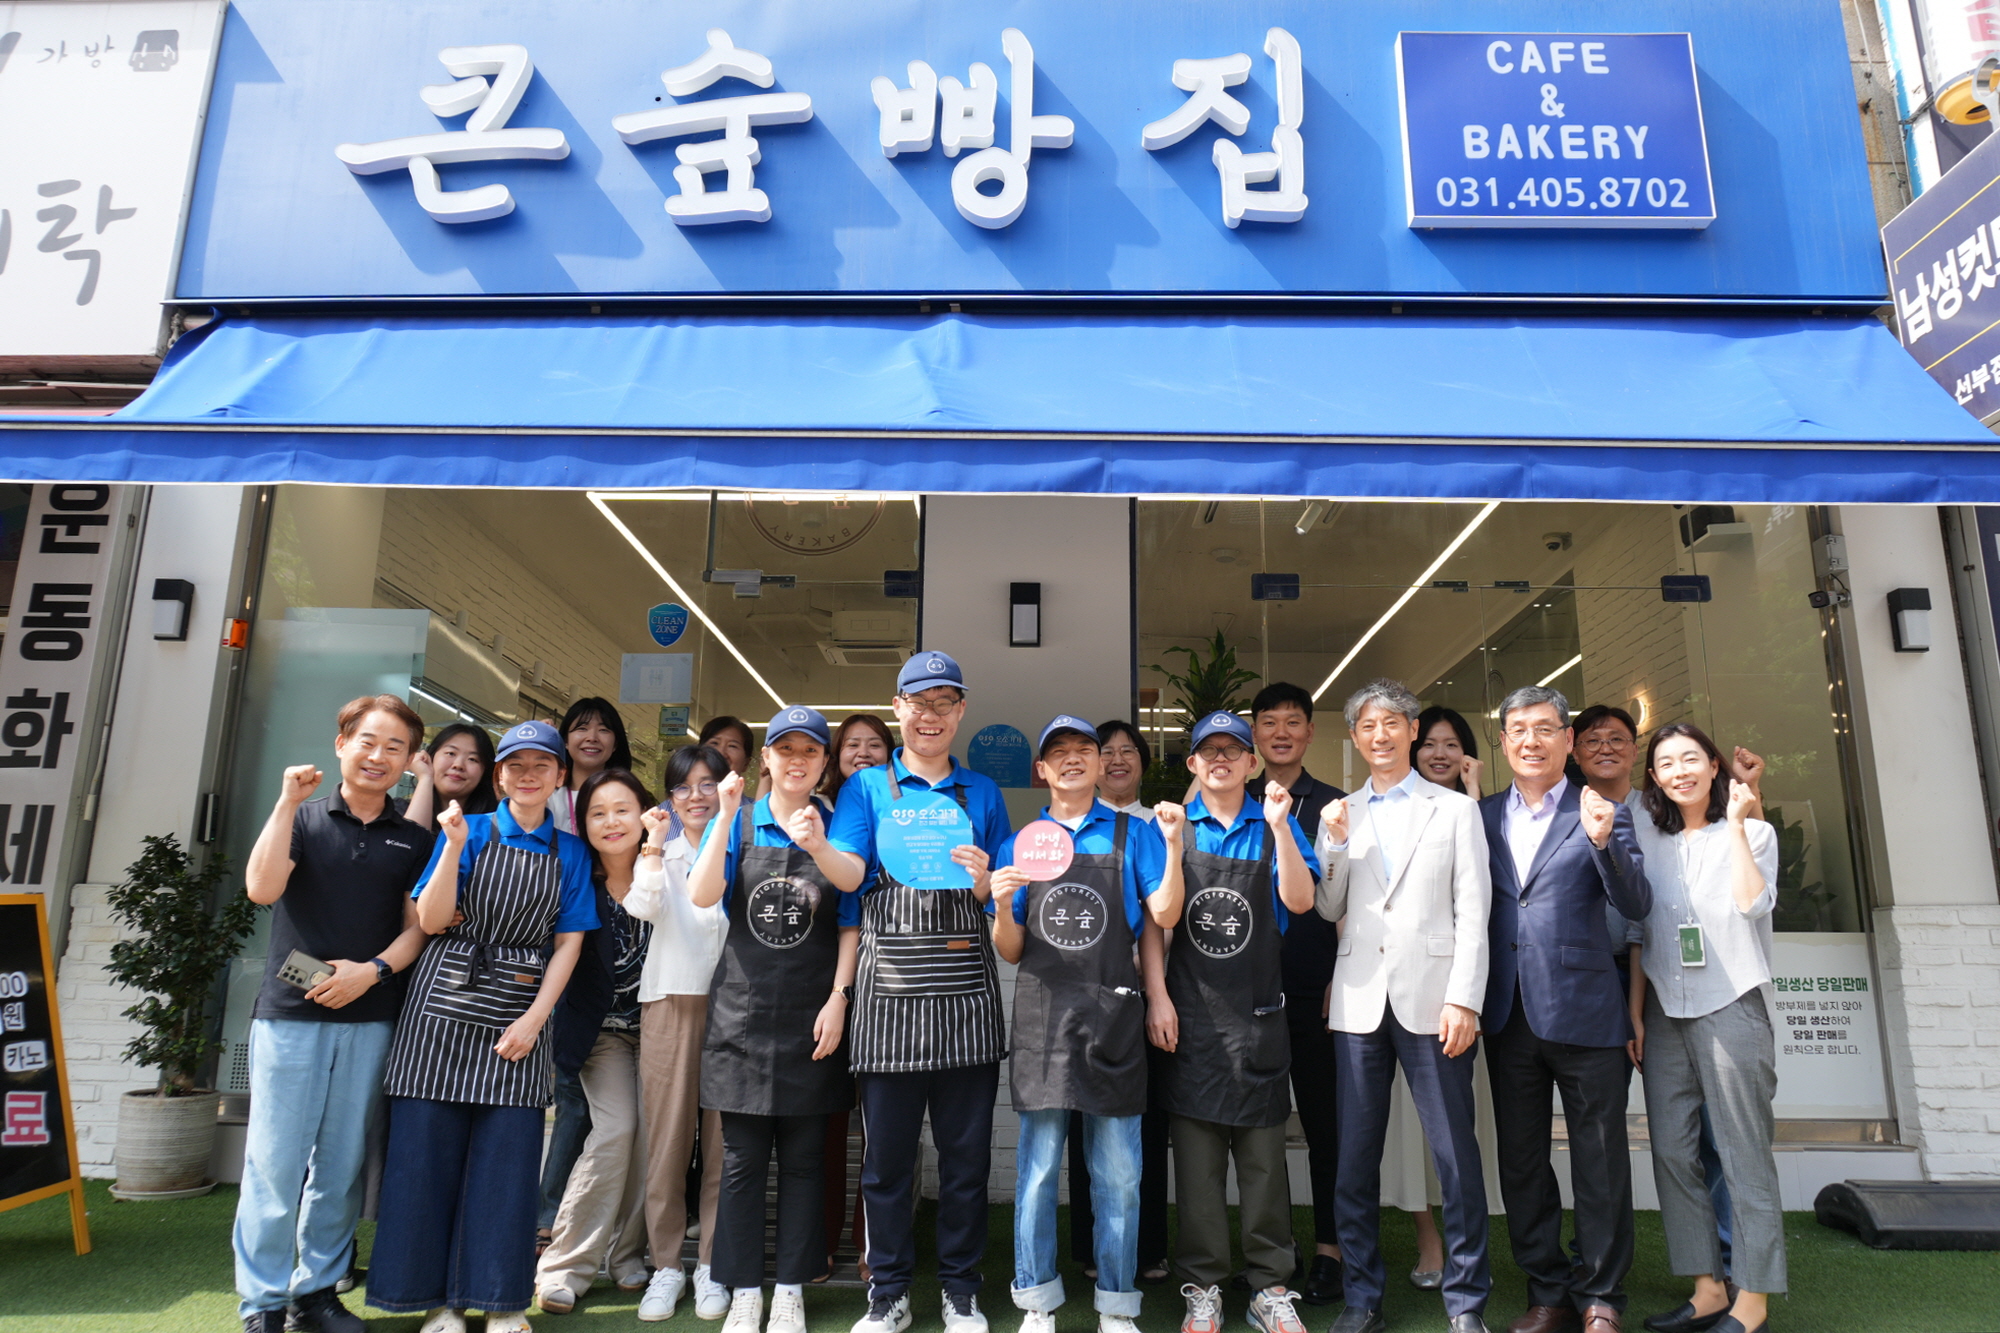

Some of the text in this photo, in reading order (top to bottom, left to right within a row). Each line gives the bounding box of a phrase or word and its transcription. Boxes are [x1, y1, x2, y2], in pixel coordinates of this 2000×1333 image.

[36, 34, 116, 69] 가방
[1486, 40, 1610, 75] CAFE
[1540, 82, 1566, 119] &
[1462, 123, 1649, 160] BAKERY
[1436, 176, 1690, 210] 031.405.8702
[1899, 214, 2000, 345] 남성컷
[651, 616, 685, 625] CLEAN
[655, 625, 679, 635] ZONE
[1047, 887, 1100, 905] BIGFOREST
[1194, 891, 1247, 912] BIGFOREST
[1816, 977, 1869, 992] 당일판매
[1775, 1000, 1816, 1011] 방부제를
[1841, 1000, 1863, 1011] 않아
[1786, 1015, 1851, 1026] 당일 생산하여
[1793, 1029, 1848, 1041] 당일 판매를
[1783, 1044, 1862, 1055] 원칙으로 합니다.
